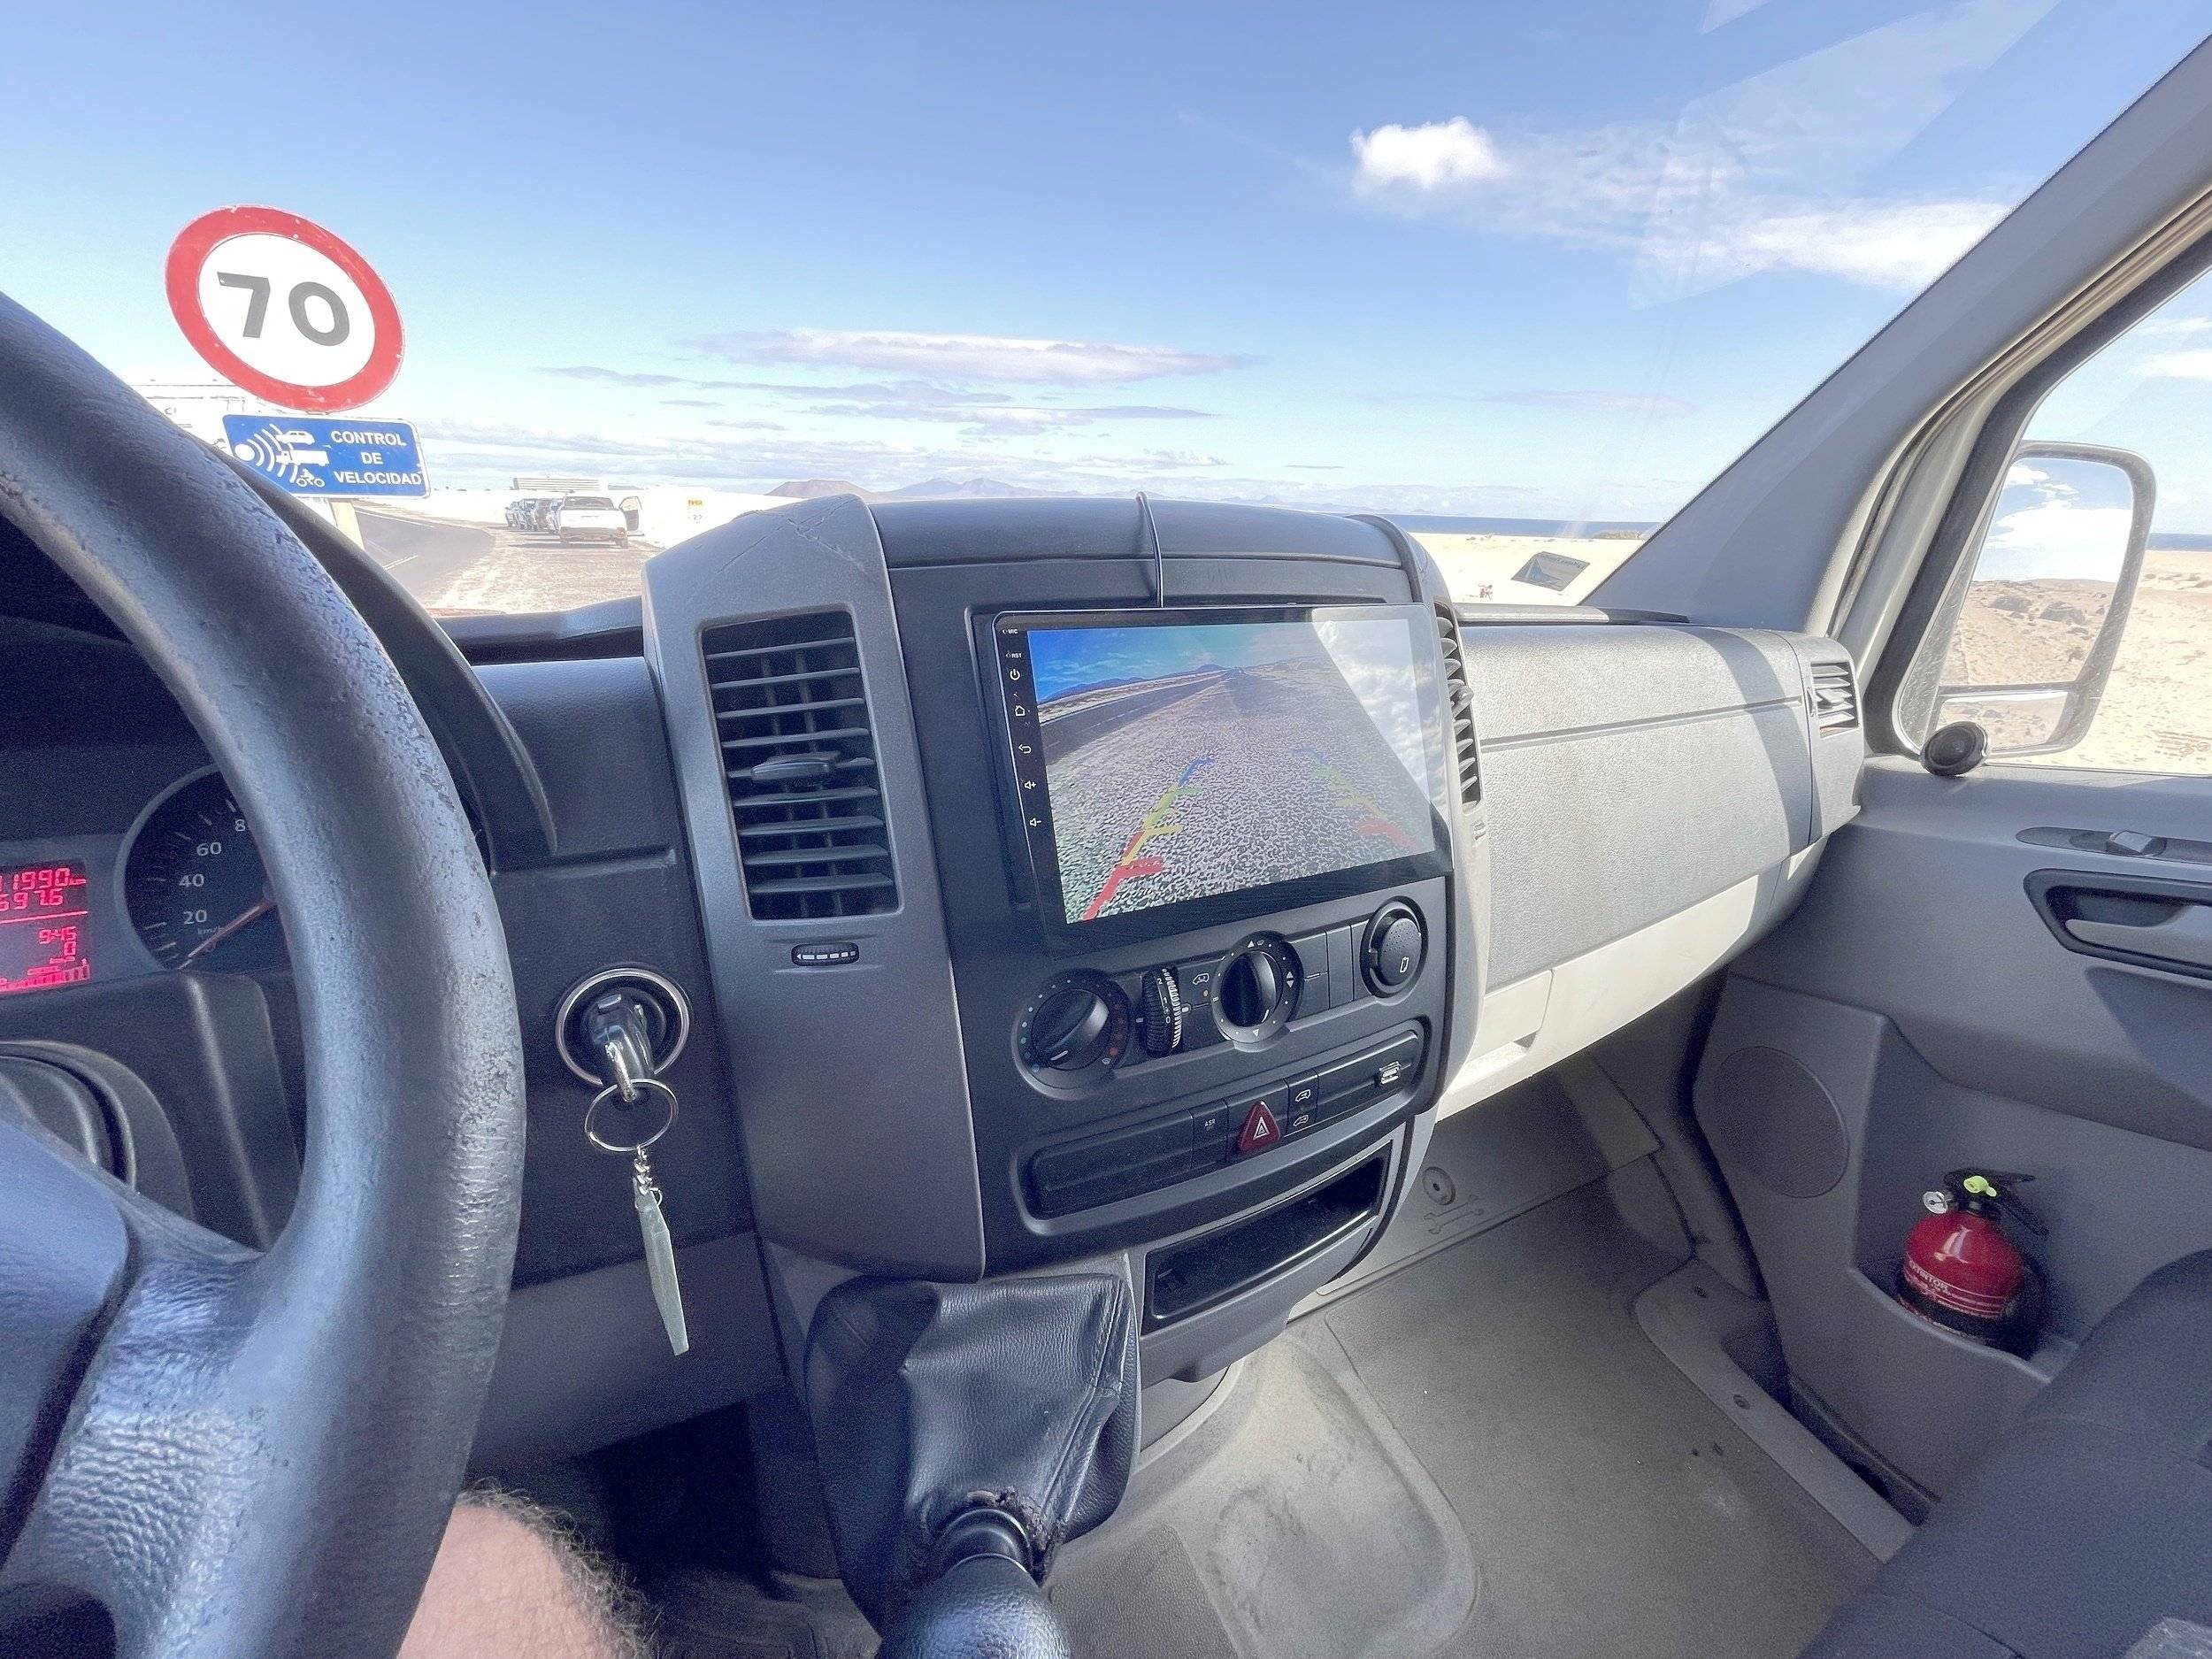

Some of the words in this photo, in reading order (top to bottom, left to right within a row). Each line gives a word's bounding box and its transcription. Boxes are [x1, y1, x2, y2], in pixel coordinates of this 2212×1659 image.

[217, 272, 350, 347] 70
[331, 430, 407, 446] CONTROL
[361, 451, 384, 465] DE
[333, 471, 422, 485] VELOCIDAD
[234, 818, 246, 832] 8
[196, 841, 222, 856] 60
[179, 873, 205, 887] 40
[183, 910, 208, 925] 20
